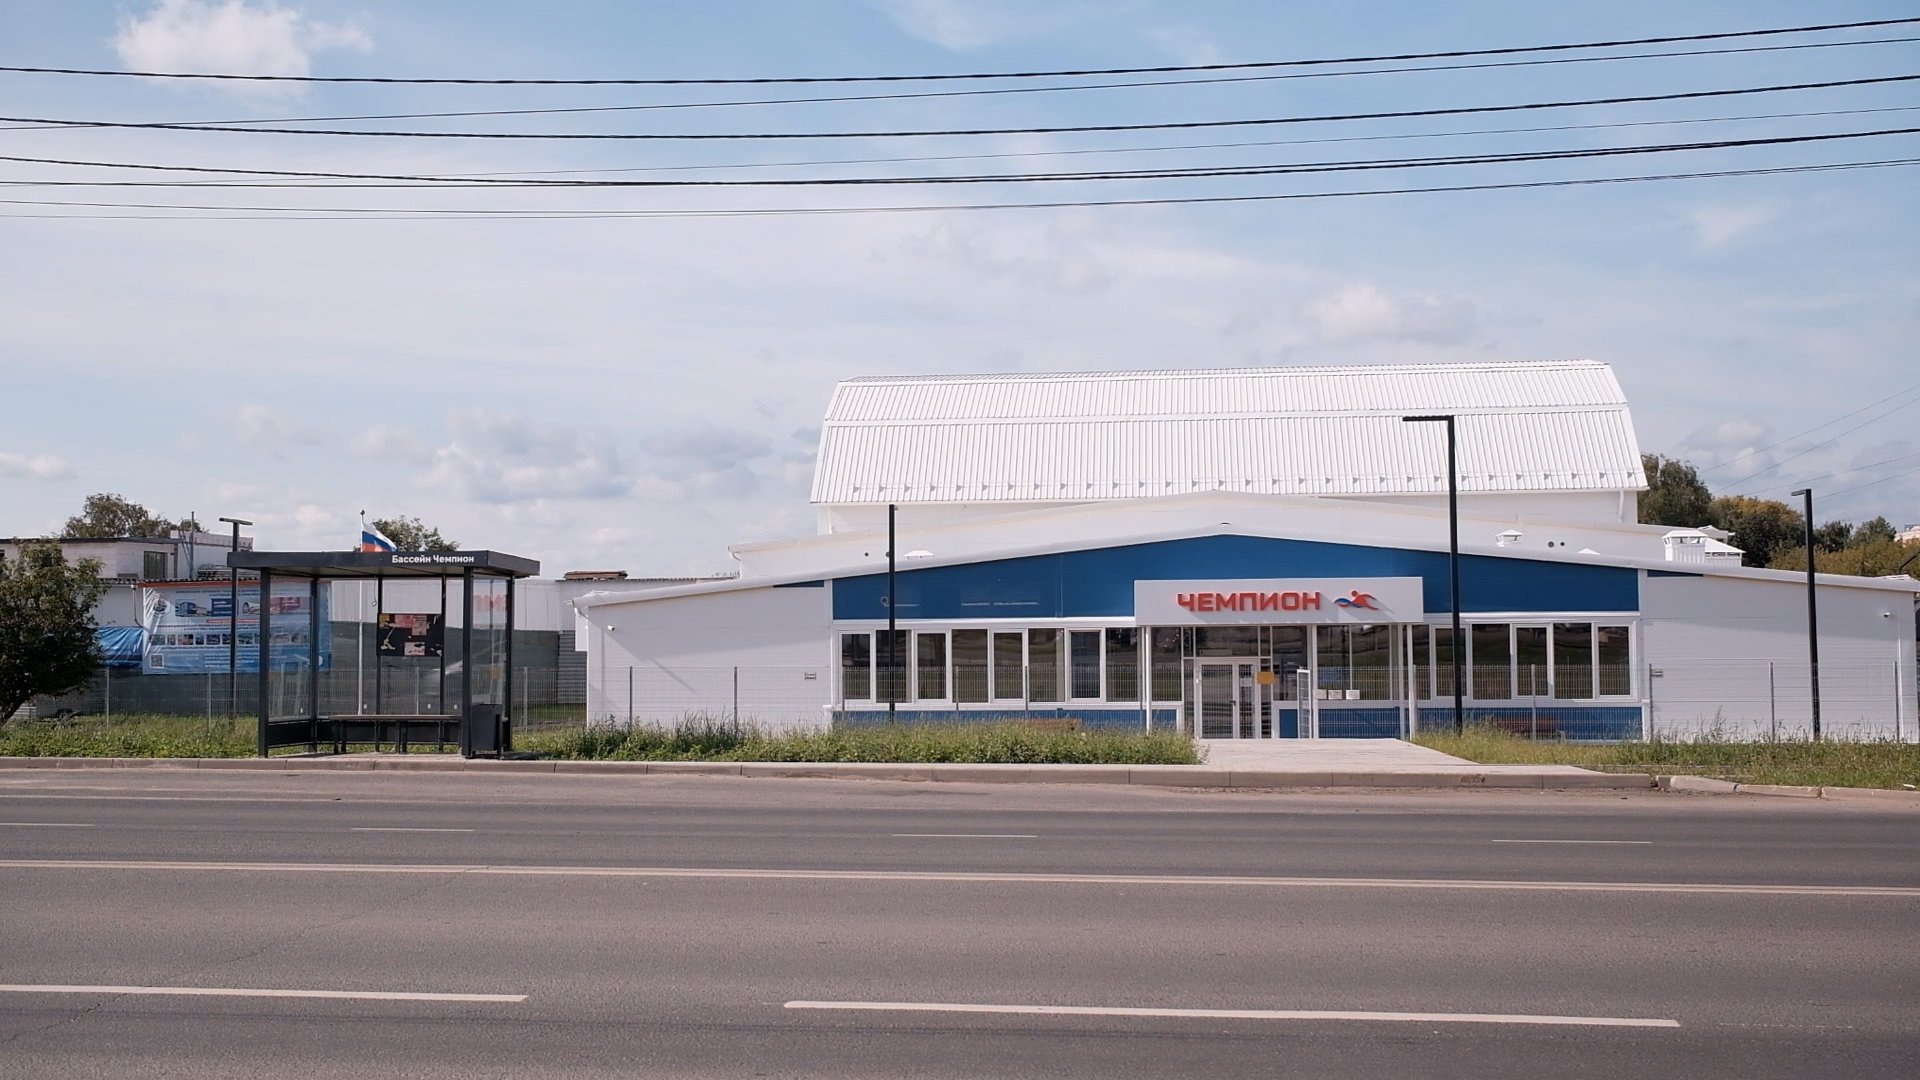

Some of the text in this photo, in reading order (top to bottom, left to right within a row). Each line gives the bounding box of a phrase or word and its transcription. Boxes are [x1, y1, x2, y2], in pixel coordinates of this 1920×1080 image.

[391, 554, 475, 563] Бассейн Чемпион
[1177, 592, 1321, 611] ЧЕМПИОН
